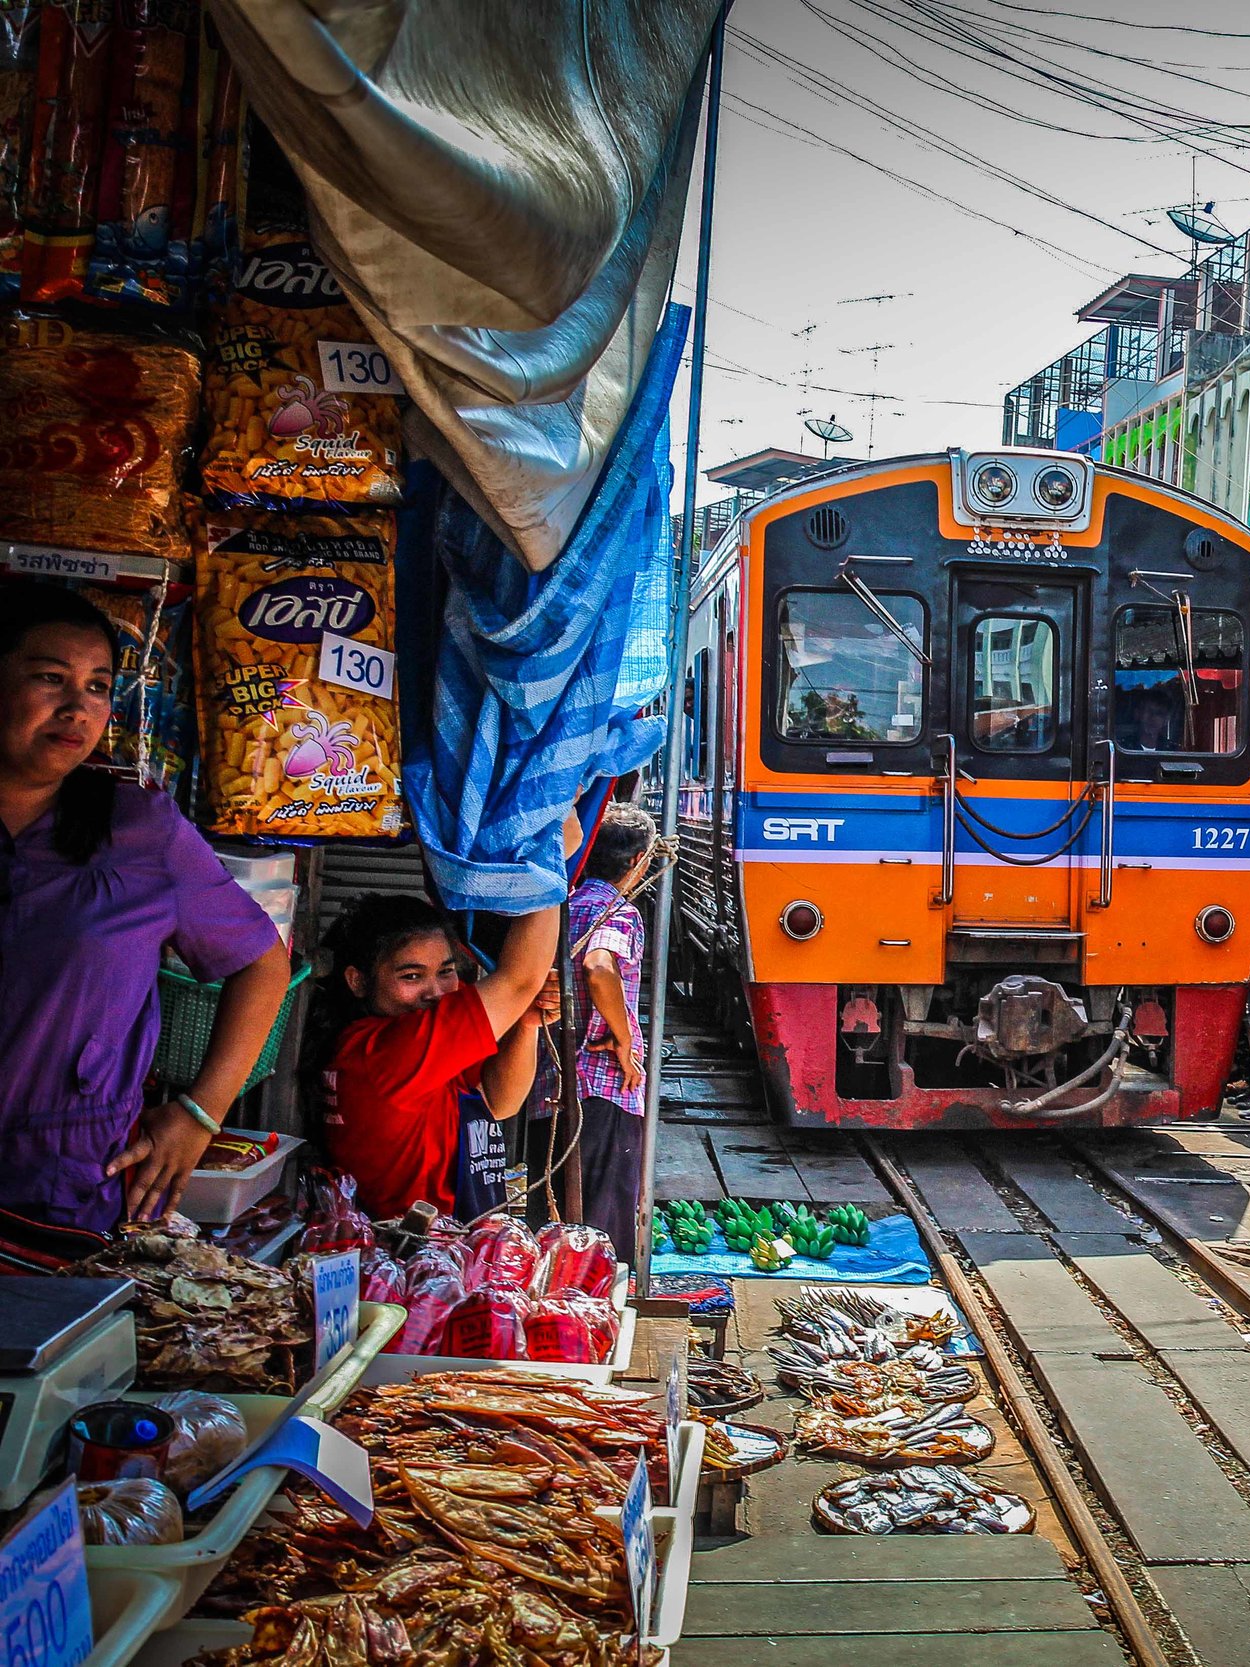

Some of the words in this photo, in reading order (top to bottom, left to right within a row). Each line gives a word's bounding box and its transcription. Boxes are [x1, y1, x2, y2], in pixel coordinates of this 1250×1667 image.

[219, 341, 263, 362] BIG
[328, 349, 391, 385] 130
[295, 431, 360, 458] Squid
[325, 449, 373, 460] Flavour
[308, 581, 335, 592] ตรา
[248, 591, 364, 629] เอสบี
[331, 645, 384, 688] 130
[231, 681, 276, 703] BIG
[310, 765, 369, 795] Squid
[338, 783, 382, 795] Flavour
[763, 818, 845, 842] SRT
[1192, 827, 1249, 851] 1227
[5, 1580, 67, 1667] 500
